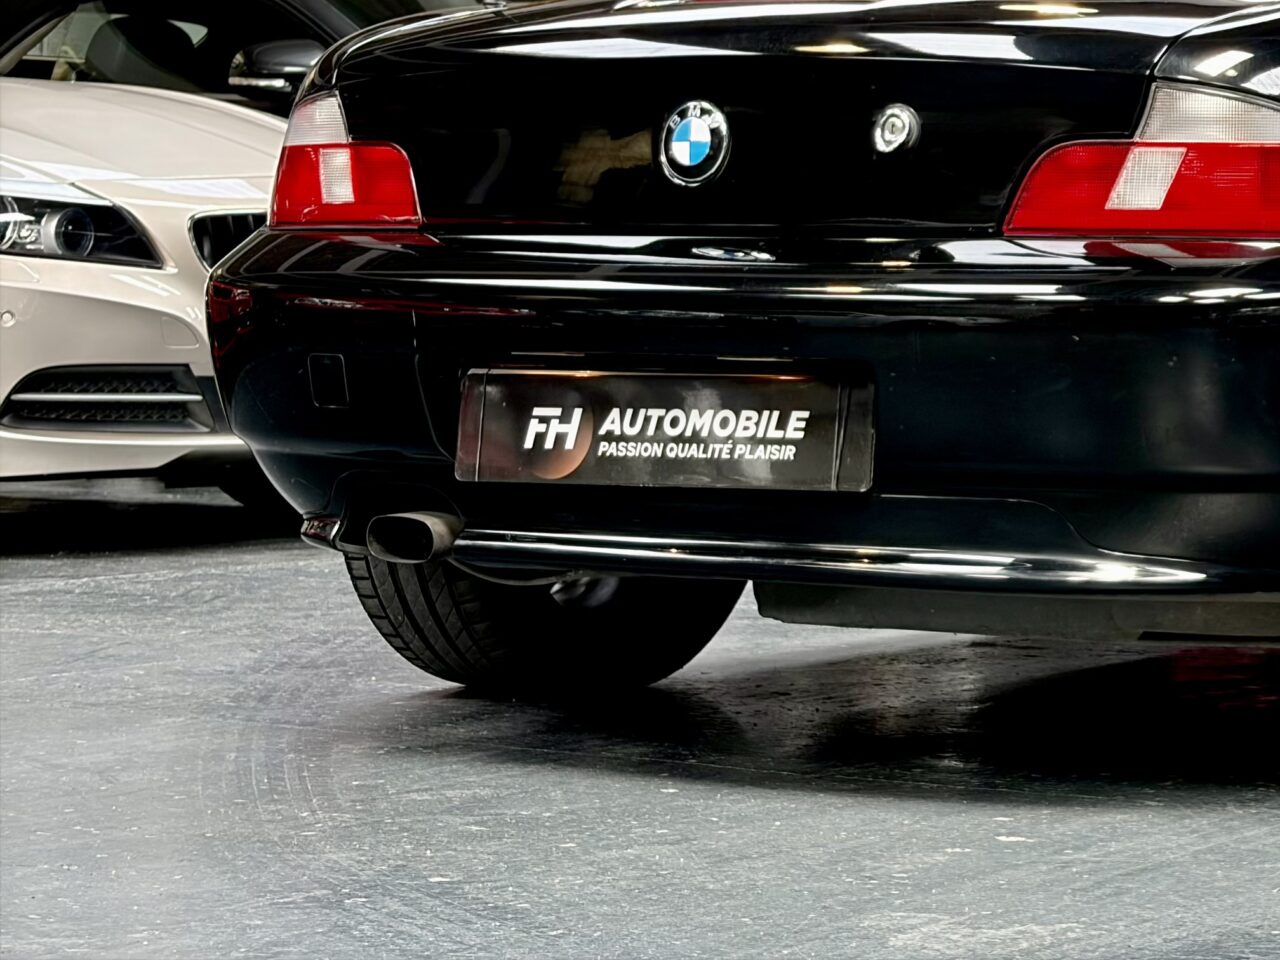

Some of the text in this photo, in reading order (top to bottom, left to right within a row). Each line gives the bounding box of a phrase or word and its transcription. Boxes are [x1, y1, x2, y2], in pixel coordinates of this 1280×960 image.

[523, 406, 811, 450] FH AUTOMOBILE
[598, 440, 797, 460] PASSION QUALITÉ PLAISIR
